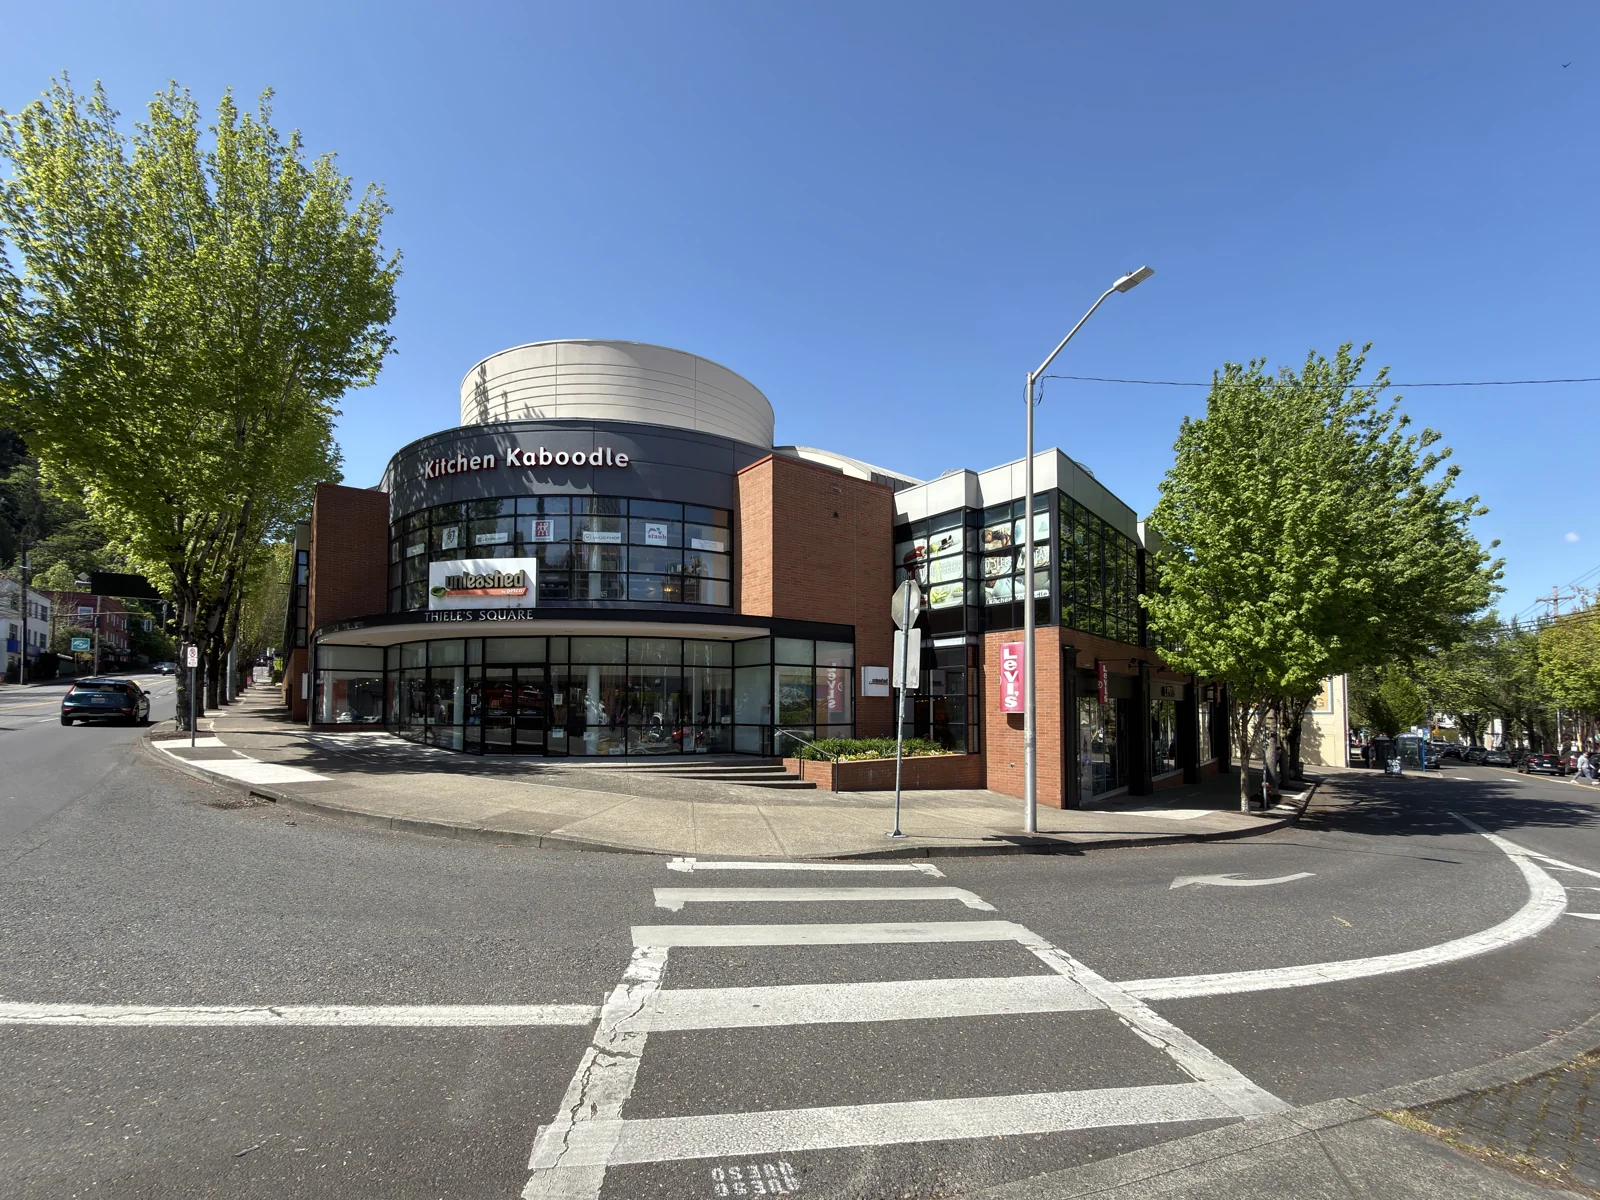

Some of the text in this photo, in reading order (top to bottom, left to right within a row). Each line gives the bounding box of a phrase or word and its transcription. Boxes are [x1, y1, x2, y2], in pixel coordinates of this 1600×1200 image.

[424, 447, 630, 480] Kitchen Kaboodle
[445, 569, 525, 589] unleashed
[424, 610, 534, 622] THIELE'S SQUARE
